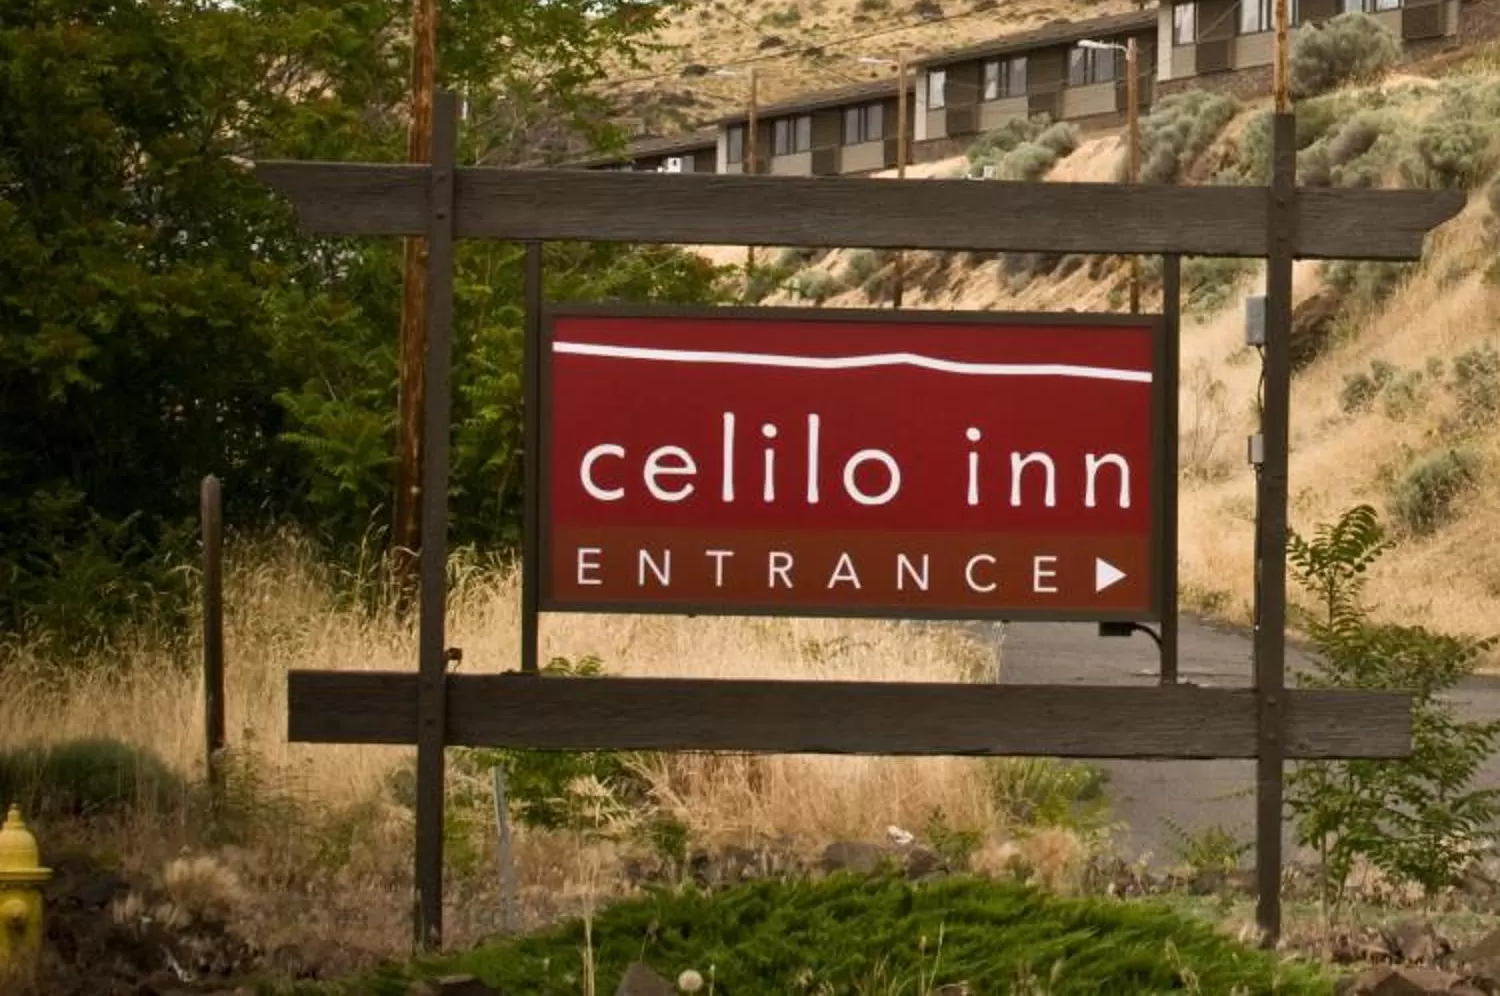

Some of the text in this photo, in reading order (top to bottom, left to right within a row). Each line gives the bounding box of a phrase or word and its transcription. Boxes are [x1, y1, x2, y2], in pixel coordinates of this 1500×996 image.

[580, 412, 1132, 508] celilo inn
[576, 547, 1058, 593] ENTRANCE
